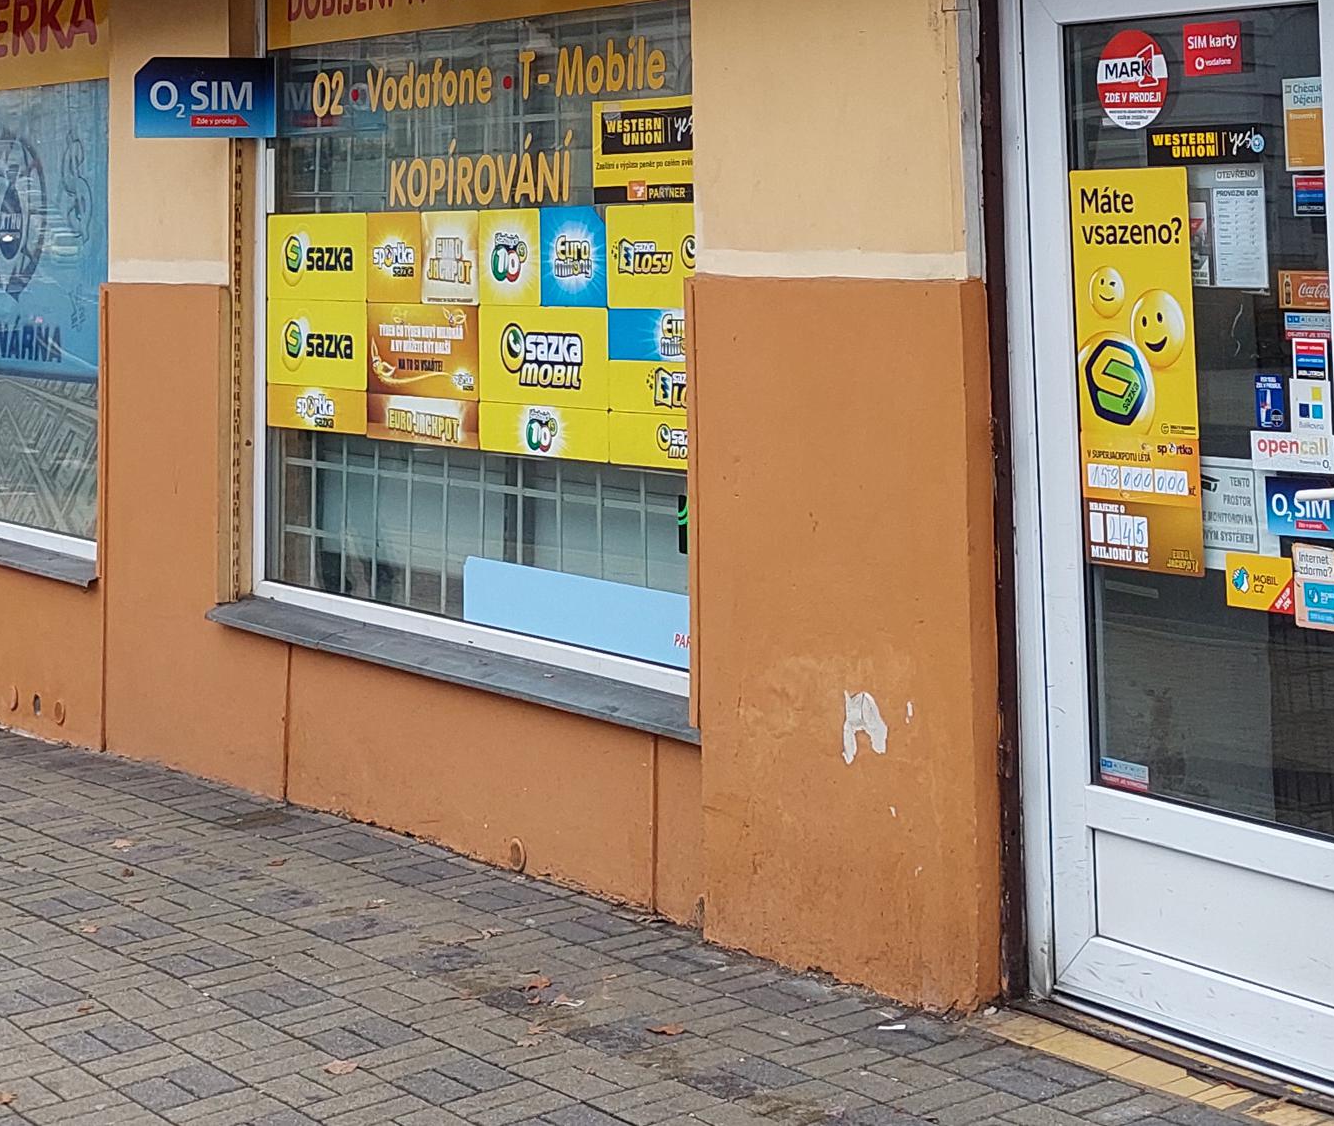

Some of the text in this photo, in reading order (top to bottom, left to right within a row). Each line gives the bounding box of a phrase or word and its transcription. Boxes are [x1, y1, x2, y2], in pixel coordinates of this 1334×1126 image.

[1187, 34, 1237, 51] SIM karty
[1205, 58, 1232, 67] vodafone
[367, 57, 494, 114] Vodafone
[190, 81, 253, 111] SIM
[1105, 92, 1161, 103] ZDE V PRODEJI
[605, 117, 662, 134] WESTERN
[623, 131, 662, 146] UNION
[1152, 132, 1216, 147] WESTERN
[1172, 144, 1216, 158] UNION
[389, 129, 574, 208] KOPÍROVÁNÍ
[1216, 168, 1256, 179] OTEVŘENO
[648, 186, 686, 199] PARTNER
[1080, 186, 1134, 215] Máte
[1081, 217, 1182, 246] vsazeno?
[427, 258, 472, 284] JACKPOT
[634, 251, 673, 274] LOSY
[1157, 443, 1193, 456] sportka
[1258, 437, 1328, 457] opencall
[1229, 476, 1250, 488] TENTO
[1223, 494, 1252, 507] PROSTOR
[1294, 497, 1331, 519] SIM
[1091, 545, 1132, 562] MILIONŮ
[1253, 574, 1279, 586] MOBIL
